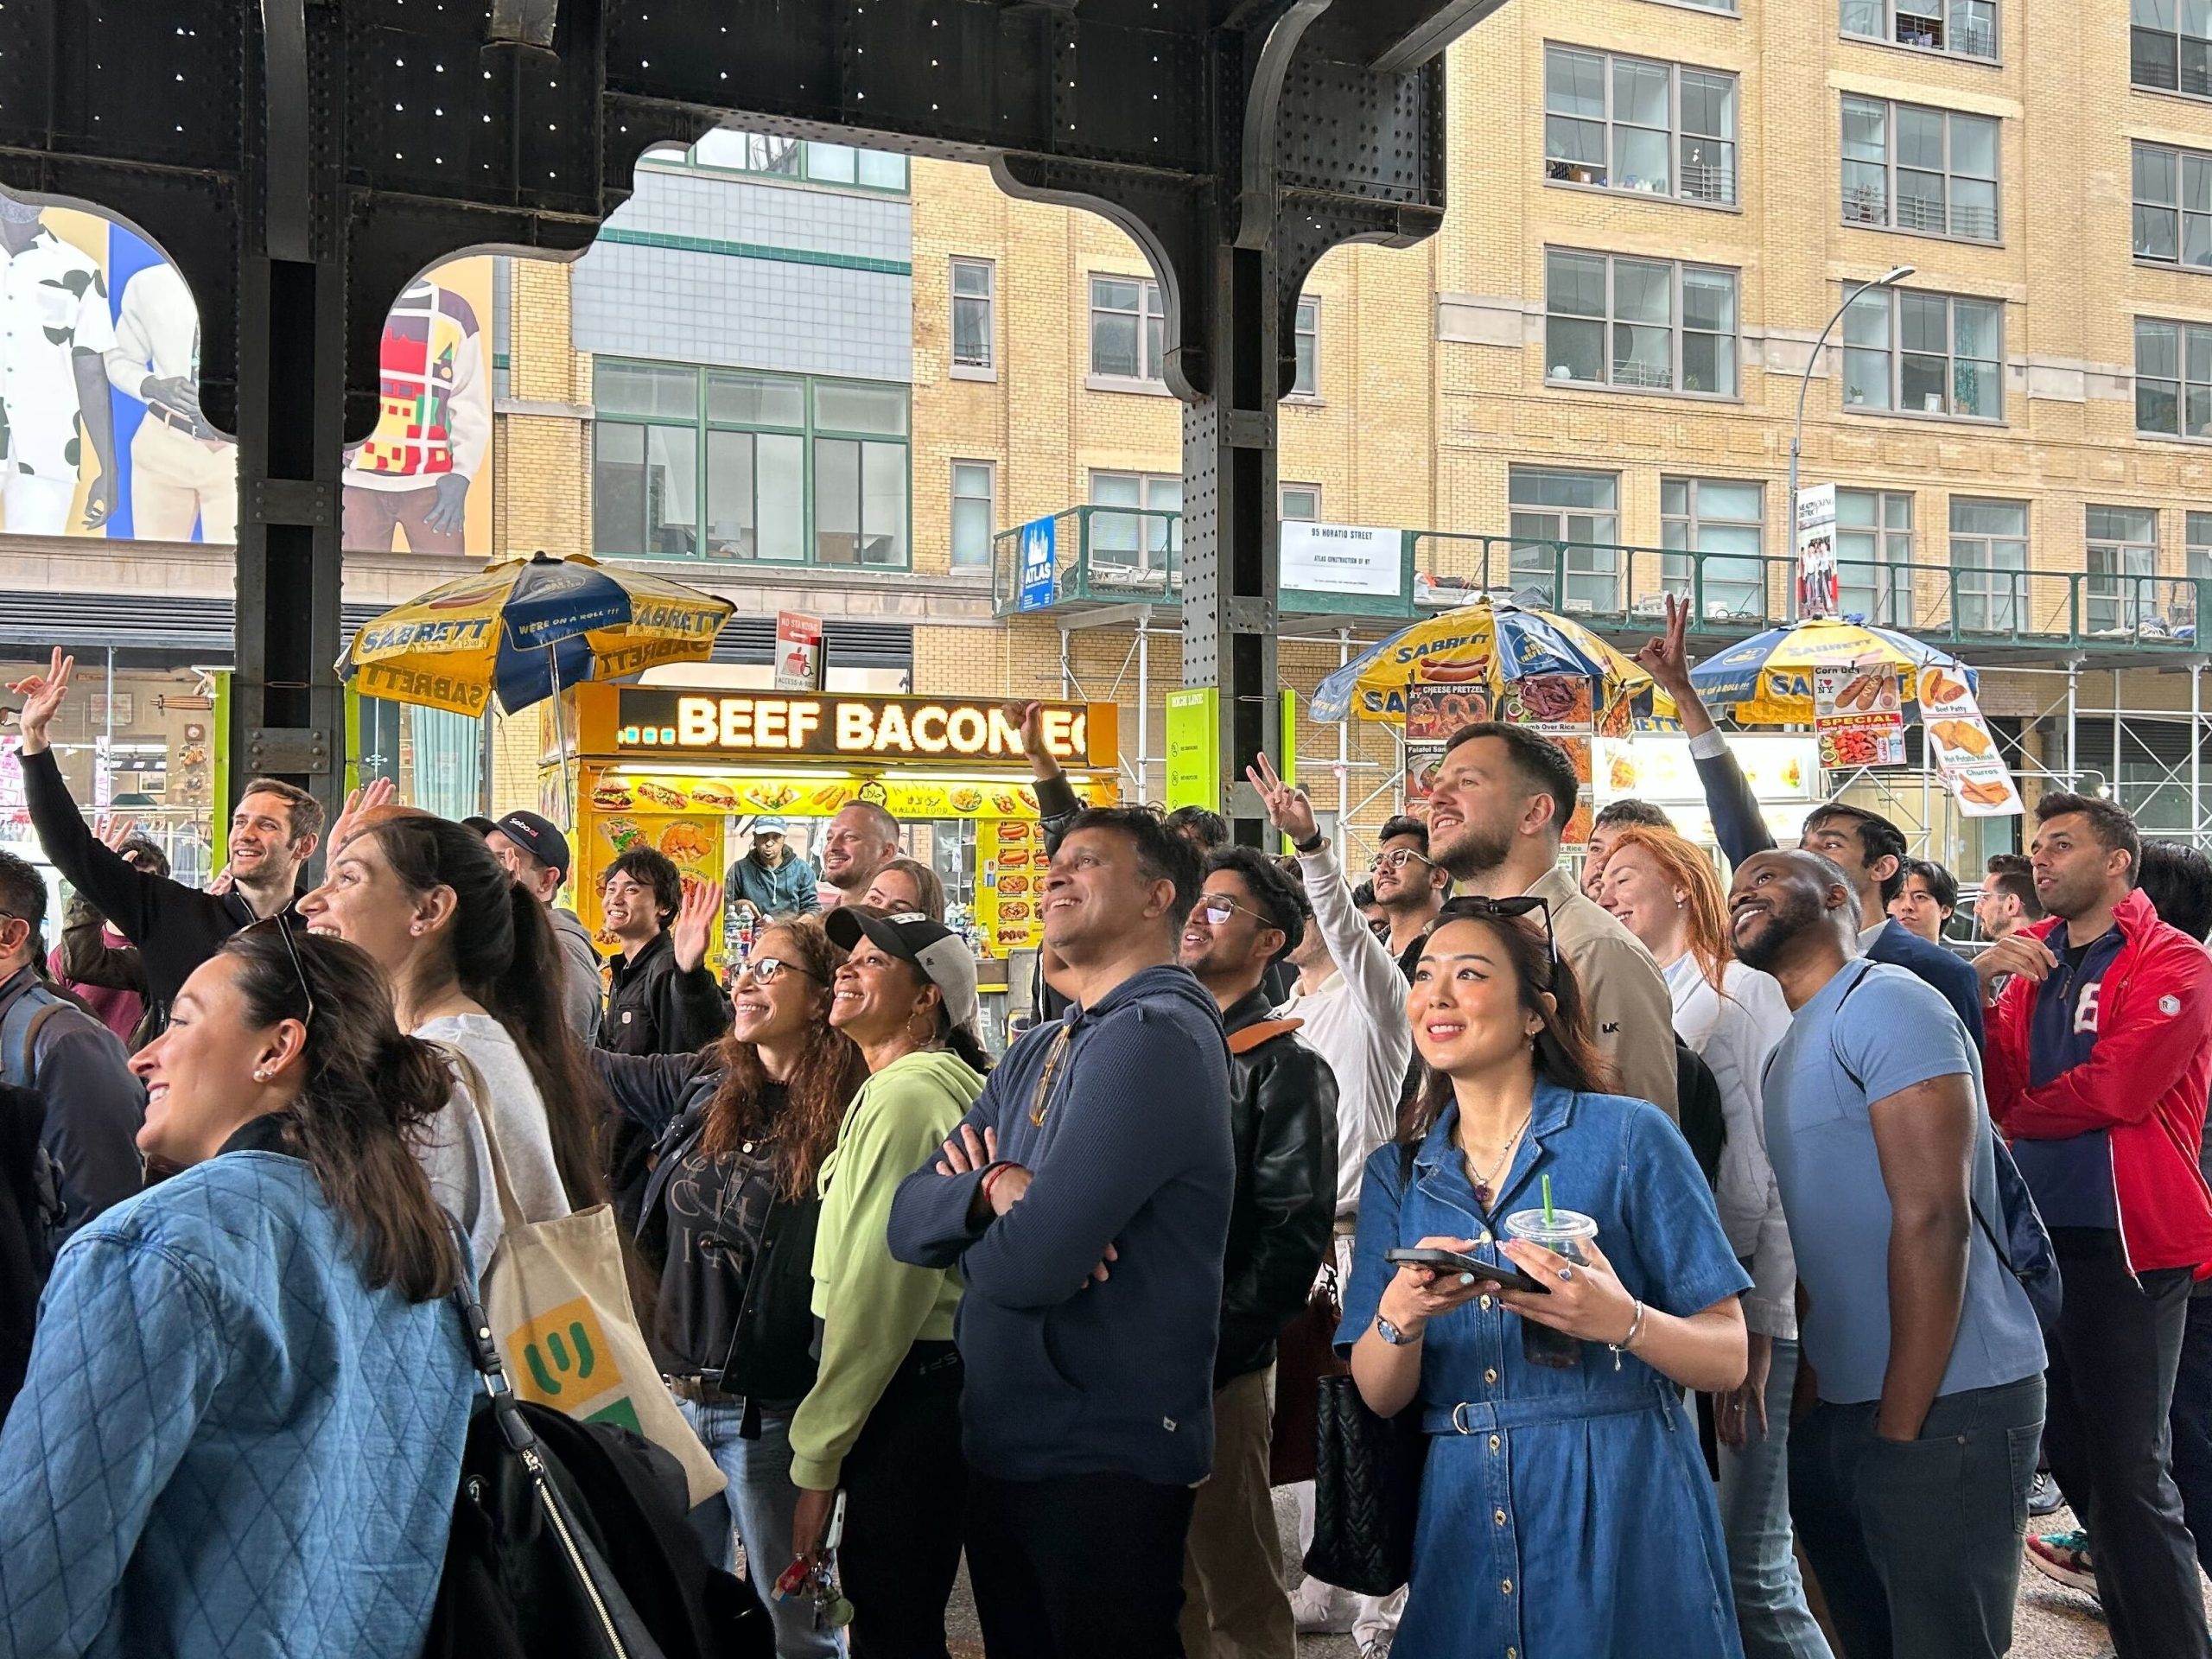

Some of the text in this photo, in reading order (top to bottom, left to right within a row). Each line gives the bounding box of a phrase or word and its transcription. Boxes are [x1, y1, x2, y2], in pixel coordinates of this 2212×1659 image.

[1312, 528, 1372, 540] 95 HORATIO STREET
[1026, 563, 1051, 584] ATLAS
[553, 617, 568, 626] ON
[580, 611, 603, 621] ROLL
[781, 617, 790, 626] NO
[362, 616, 493, 653] SABRETT
[1395, 633, 1490, 664] SABRETT
[1422, 685, 1451, 694] CHEESE
[1171, 693, 1204, 707] HIGH LINE
[677, 697, 820, 748] BEEF
[1821, 715, 1895, 726] SPECIAL
